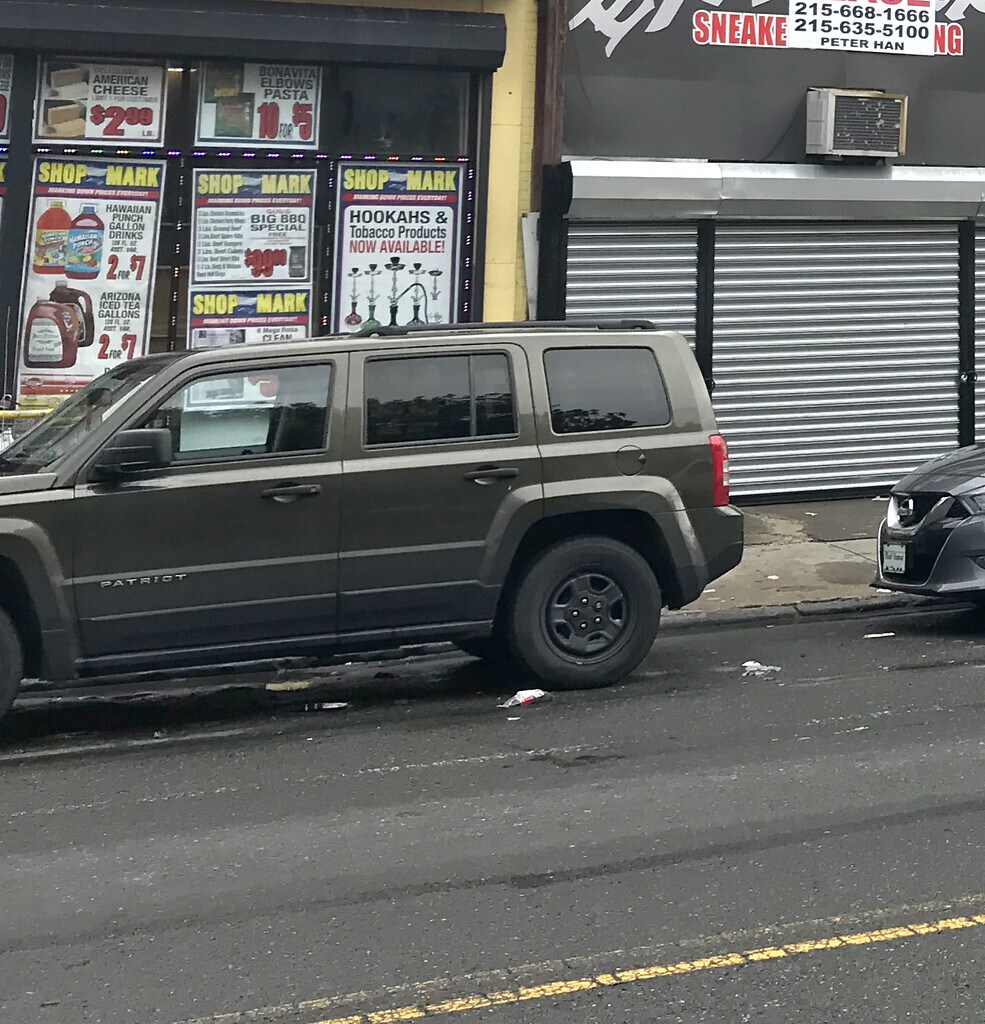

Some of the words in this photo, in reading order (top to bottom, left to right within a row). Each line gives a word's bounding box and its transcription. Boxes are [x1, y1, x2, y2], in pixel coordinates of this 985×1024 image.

[794, 2, 930, 23] 215-668-1666
[693, 10, 788, 47] SNEAKE
[794, 18, 929, 39] 215-635-5100
[820, 37, 869, 49] PETER
[873, 40, 905, 51] HAN
[260, 66, 316, 78] BONAVITA
[93, 75, 148, 87] AMERICAN
[261, 78, 314, 89] ELBOWS
[93, 85, 148, 96] CHEESE
[264, 89, 309, 100] PASTA
[257, 102, 279, 139] 10
[38, 162, 88, 184] SHOP
[106, 165, 160, 187] MARK
[343, 168, 390, 191] SHOP
[406, 170, 457, 191] MARK
[198, 174, 244, 195] SHOP
[261, 174, 311, 195] MARK
[106, 204, 152, 214] HAWAIIAN
[112, 213, 143, 222] PUNCH
[251, 214, 276, 223] BIG
[280, 214, 306, 223] BBQ
[350, 210, 430, 223] HOOKAHS
[435, 211, 448, 224] &
[109, 222, 145, 231] GALLON
[350, 225, 395, 238] Tobacco
[398, 225, 446, 238] Products
[109, 231, 143, 240] DRINKS
[350, 240, 377, 253] NOW
[380, 240, 445, 253] AVAILABLE!
[106, 254, 119, 280] 2
[117, 270, 130, 280] FOR
[130, 254, 146, 280] $7
[100, 292, 141, 301] ARIZONA
[99, 301, 120, 309] ICED
[193, 294, 239, 315] SHOP
[256, 292, 308, 313] MARK
[98, 310, 140, 318] GALLONS
[97, 333, 110, 359] 2
[109, 349, 122, 359] FOR
[121, 333, 137, 359] $7
[100, 573, 187, 588] PATRIOT
